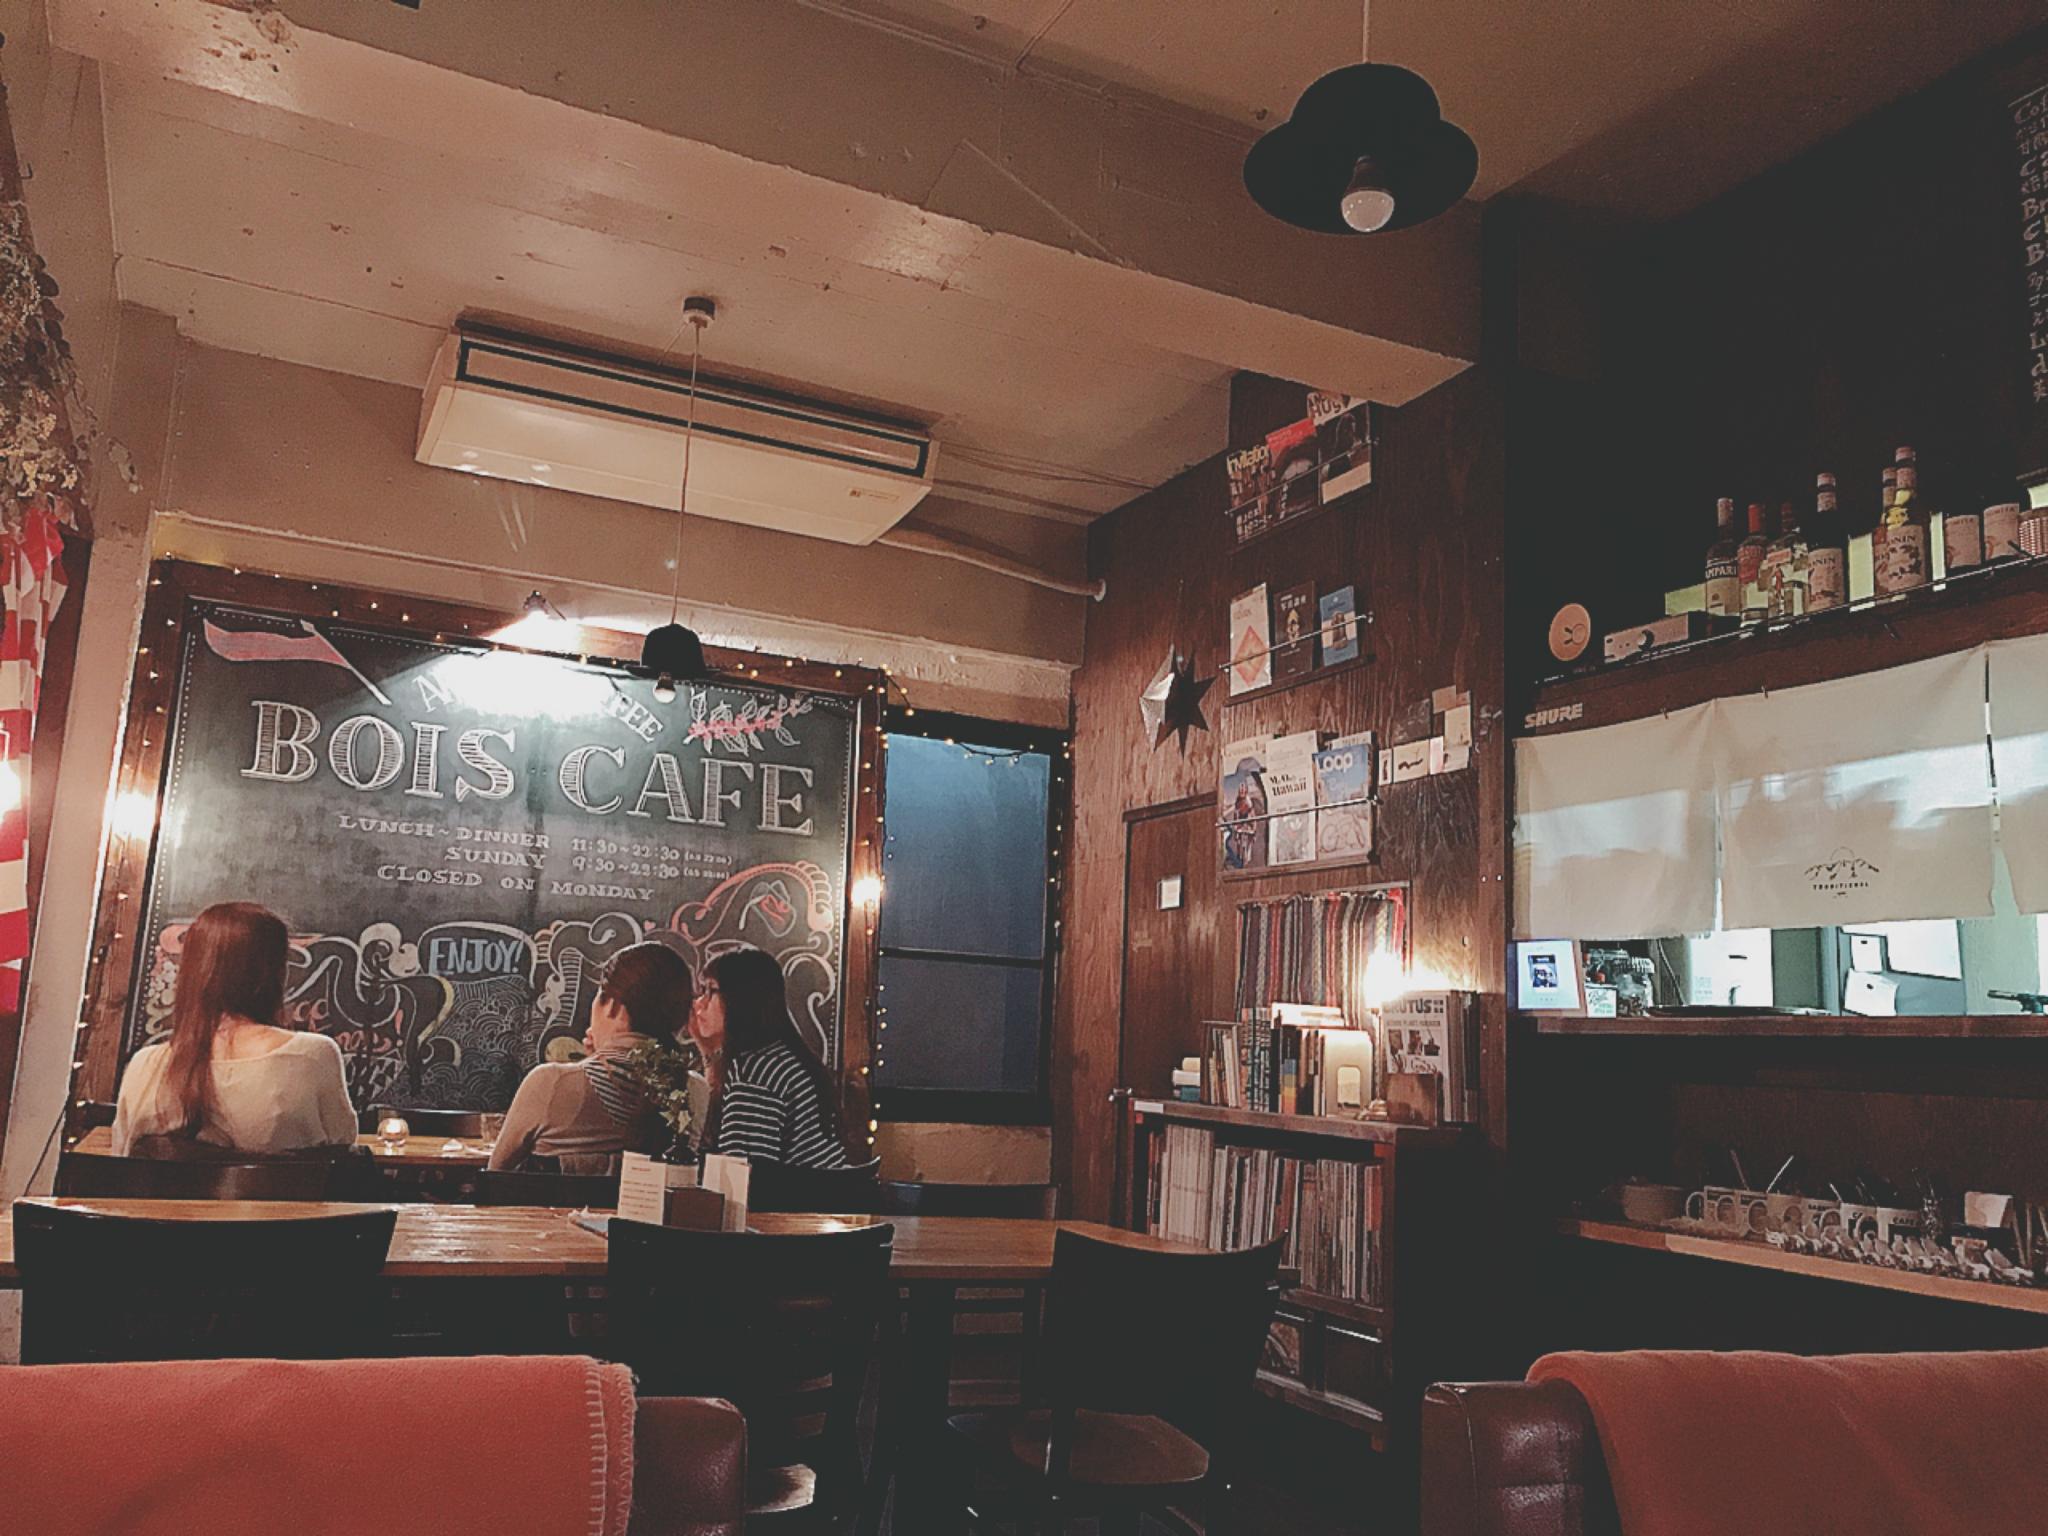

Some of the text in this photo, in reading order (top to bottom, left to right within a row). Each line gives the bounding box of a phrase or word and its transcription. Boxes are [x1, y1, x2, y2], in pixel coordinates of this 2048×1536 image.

[1524, 702, 1583, 729] SHURE
[239, 700, 814, 836] BOIS CAFE
[444, 847, 548, 869] SUNDAY
[377, 864, 655, 901] CLOSED ON MONDAY
[428, 936, 525, 976] ENJOY!
